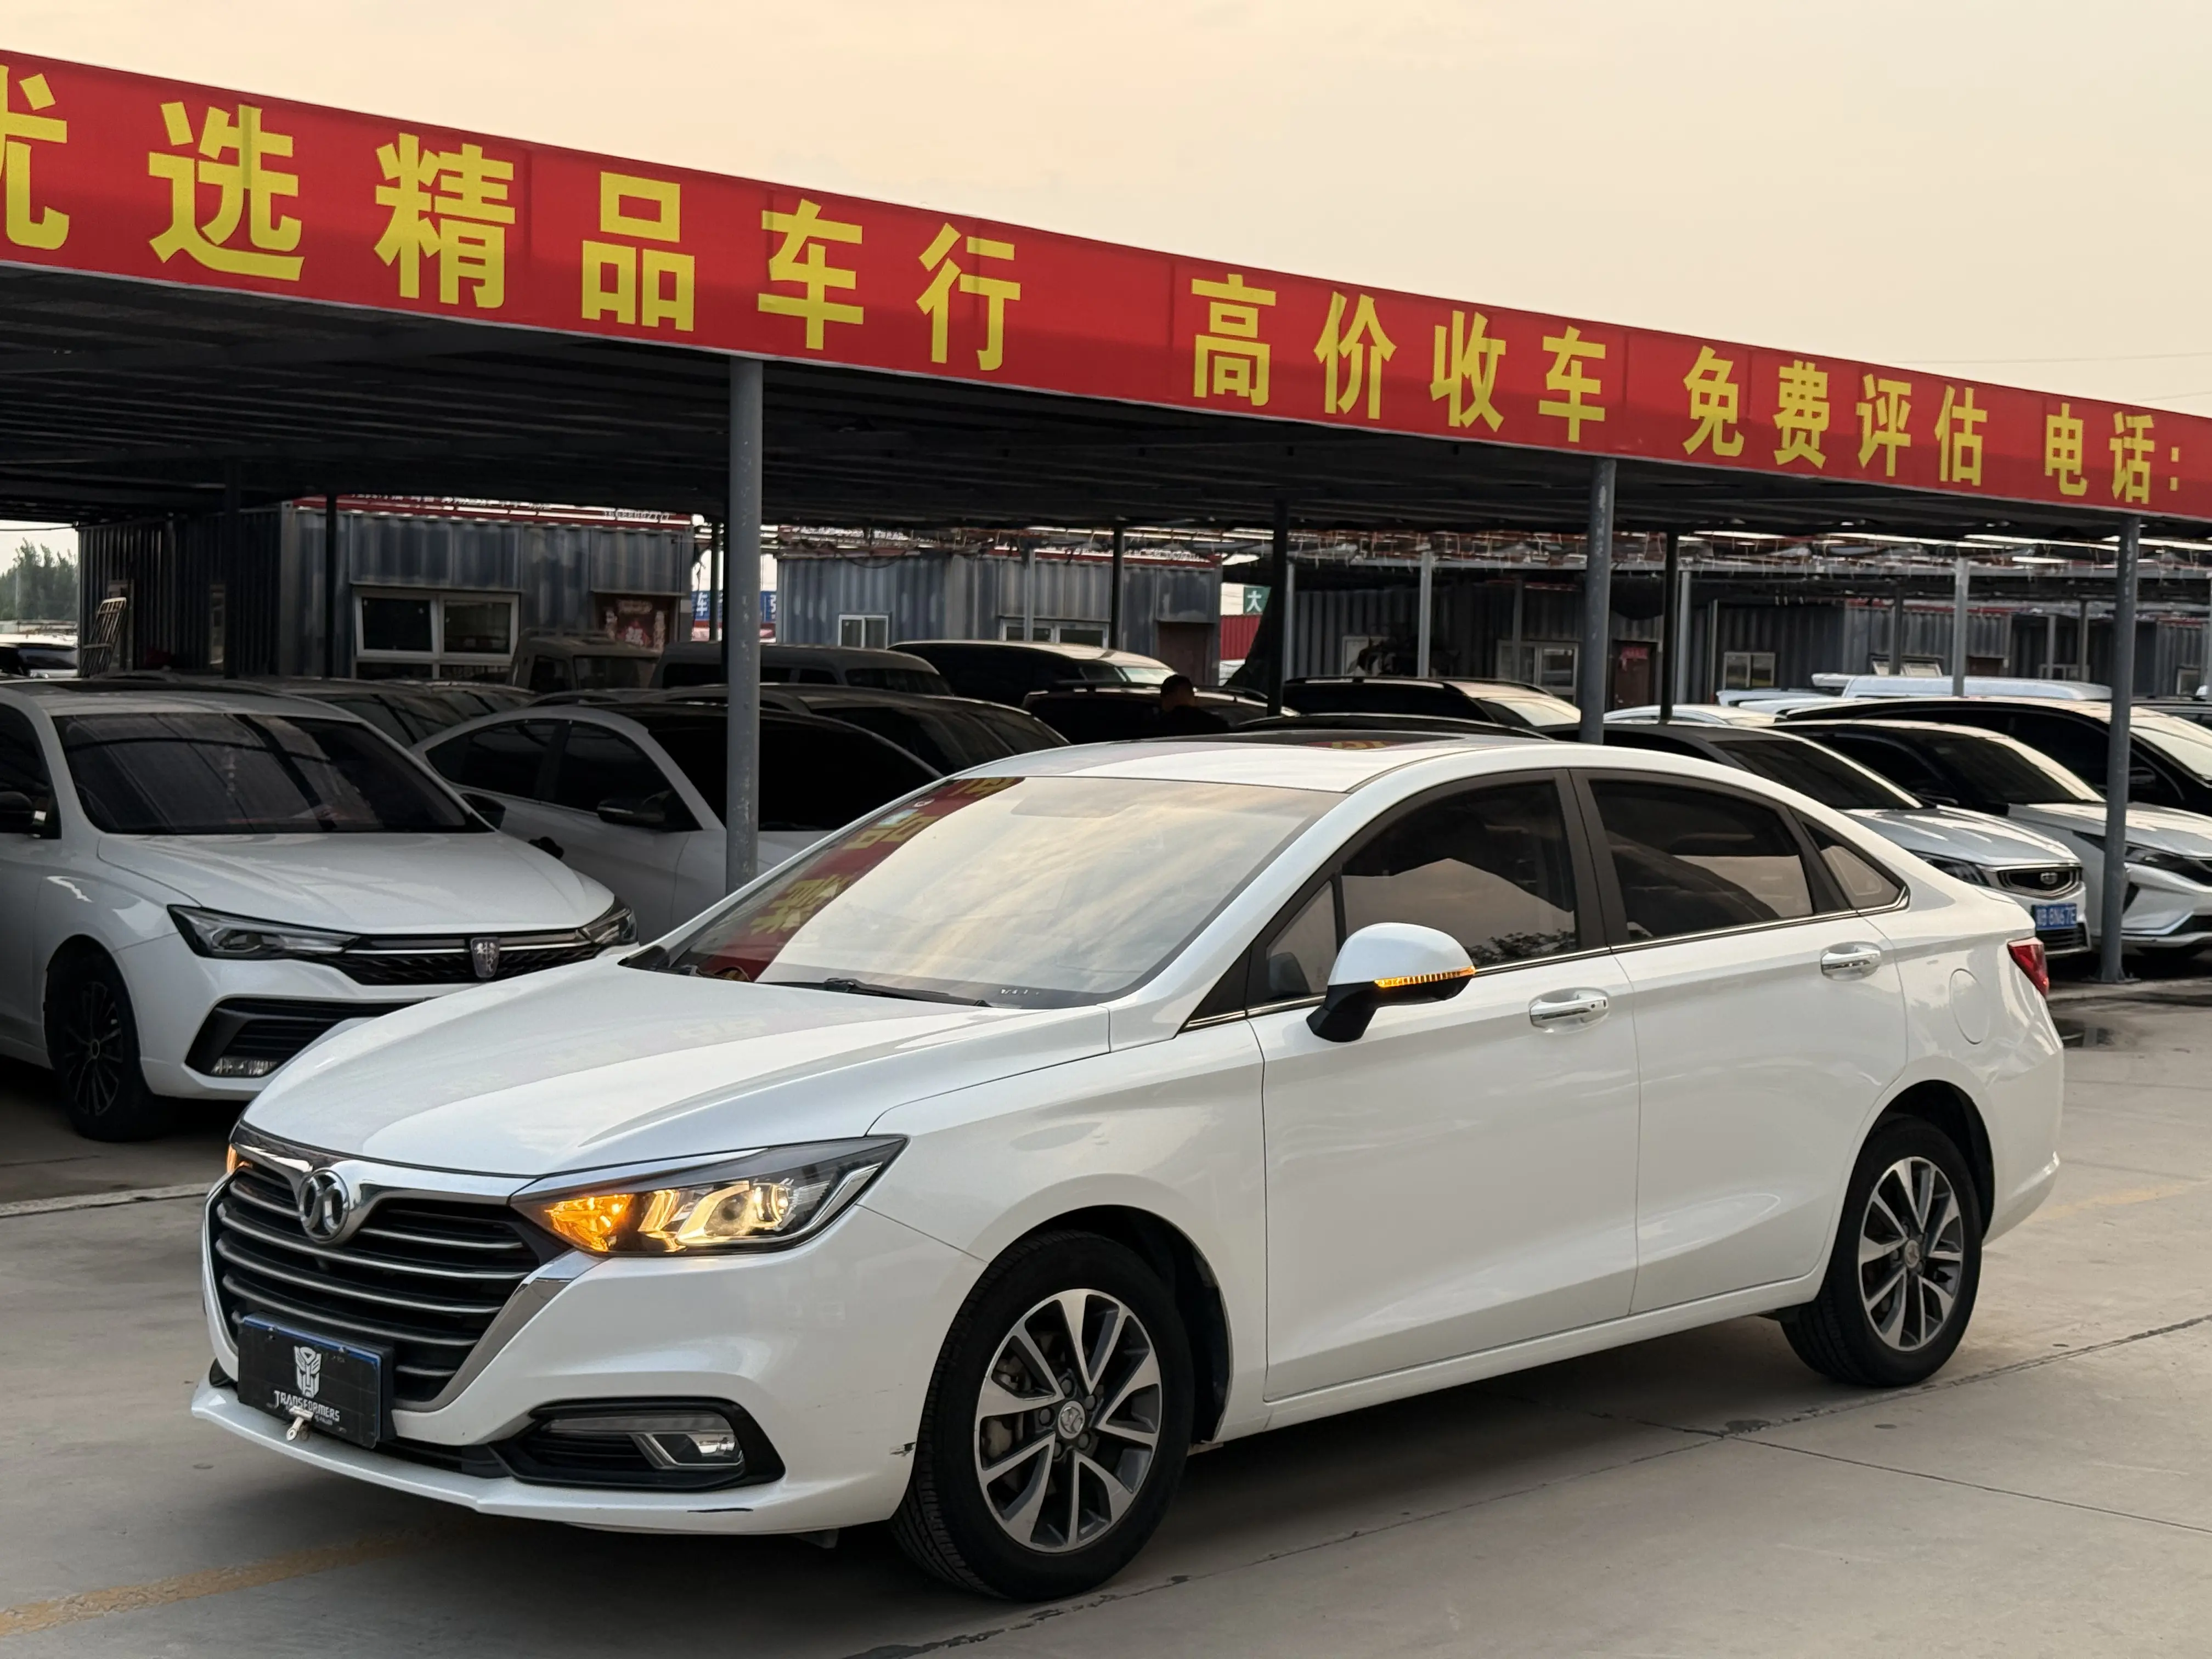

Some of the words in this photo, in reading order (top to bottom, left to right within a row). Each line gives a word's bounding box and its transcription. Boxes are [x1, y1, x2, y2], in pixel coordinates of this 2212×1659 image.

[1191, 274, 1606, 443] 高价收车
[1683, 346, 1988, 486] 免费评估
[2045, 403, 2179, 504] 电话：
[1246, 590, 1262, 613] 大
